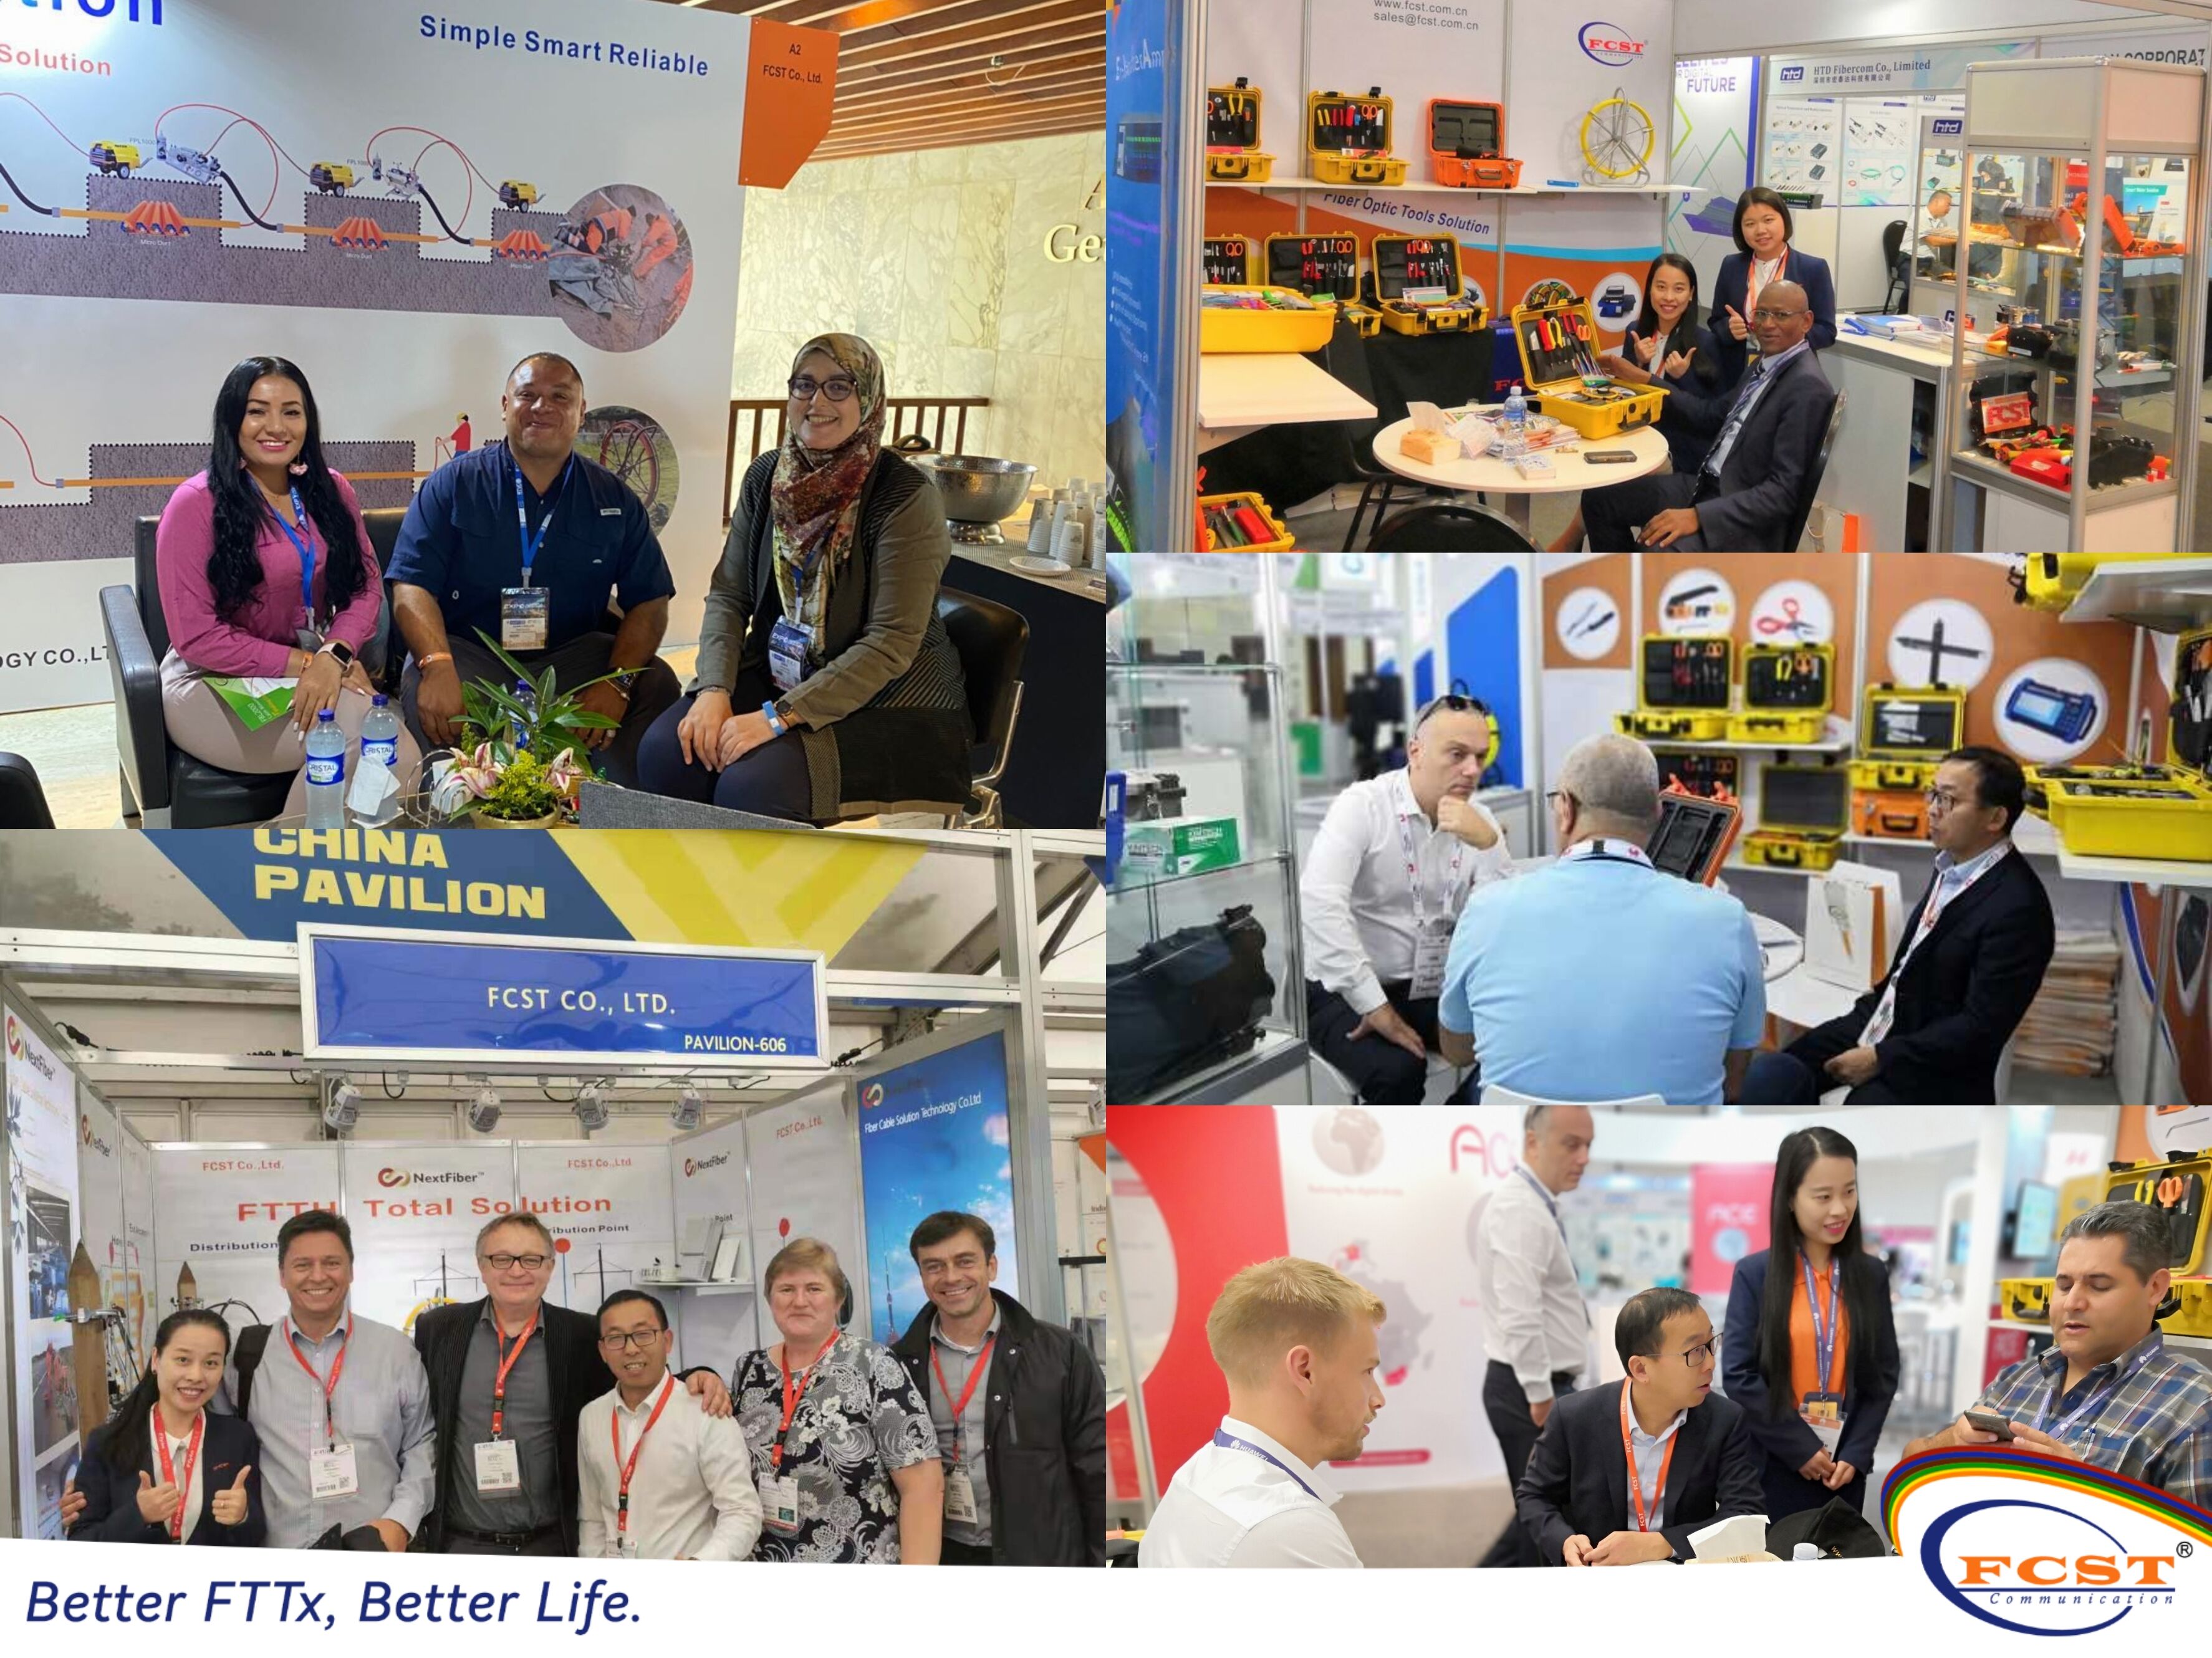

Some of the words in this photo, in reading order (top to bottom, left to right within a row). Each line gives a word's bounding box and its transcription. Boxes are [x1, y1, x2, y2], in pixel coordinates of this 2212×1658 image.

[1374, 0, 1468, 16] www.fcst.com.cn
[1373, 12, 1479, 30] sales@fcst.com.cn
[420, 15, 516, 49] Simple
[525, 31, 601, 61] Smart
[609, 42, 708, 76] Reliable
[789, 43, 802, 55] A2
[1588, 39, 1644, 54] FCST
[0, 44, 111, 76] Solution
[1814, 66, 1832, 75] HTD
[1833, 63, 1873, 75] Fibercom
[1875, 62, 1892, 73] Co.,
[1893, 59, 1931, 71] Limited
[762, 64, 787, 78] FCST
[788, 68, 805, 83] Co.,
[807, 71, 823, 84] Ltd.
[1782, 69, 1802, 79] htd
[1686, 76, 1736, 93] FUTURE
[1935, 122, 1960, 133] htd
[1362, 196, 1397, 216] Optic
[1402, 204, 1435, 223] Tools
[1437, 213, 1490, 235] Solution
[0, 651, 37, 669] GY
[253, 829, 448, 868] CHINA
[254, 865, 546, 919] PAVILION
[487, 987, 550, 1009] FCST
[560, 990, 613, 1016] CO.,
[623, 992, 676, 1015] LTD.
[685, 1033, 787, 1052] PAVILION-606
[864, 1123, 878, 1134] Fiber
[878, 1116, 895, 1130] Cable
[896, 1111, 920, 1126] Solution
[921, 1101, 957, 1119] Technology
[776, 1124, 793, 1139] FCST
[202, 1161, 234, 1171] FCST
[238, 1200, 337, 1221] FTTH
[363, 1197, 453, 1218] Total
[471, 1197, 611, 1216] Solution
[715, 1214, 733, 1222] Point
[598, 1223, 629, 1233] Point
[190, 1240, 279, 1252] Distribution
[2145, 1344, 2160, 1359] HUAWEI
[2067, 1407, 2086, 1424] HUAWEI
[1239, 1445, 1269, 1462] HUAWEI
